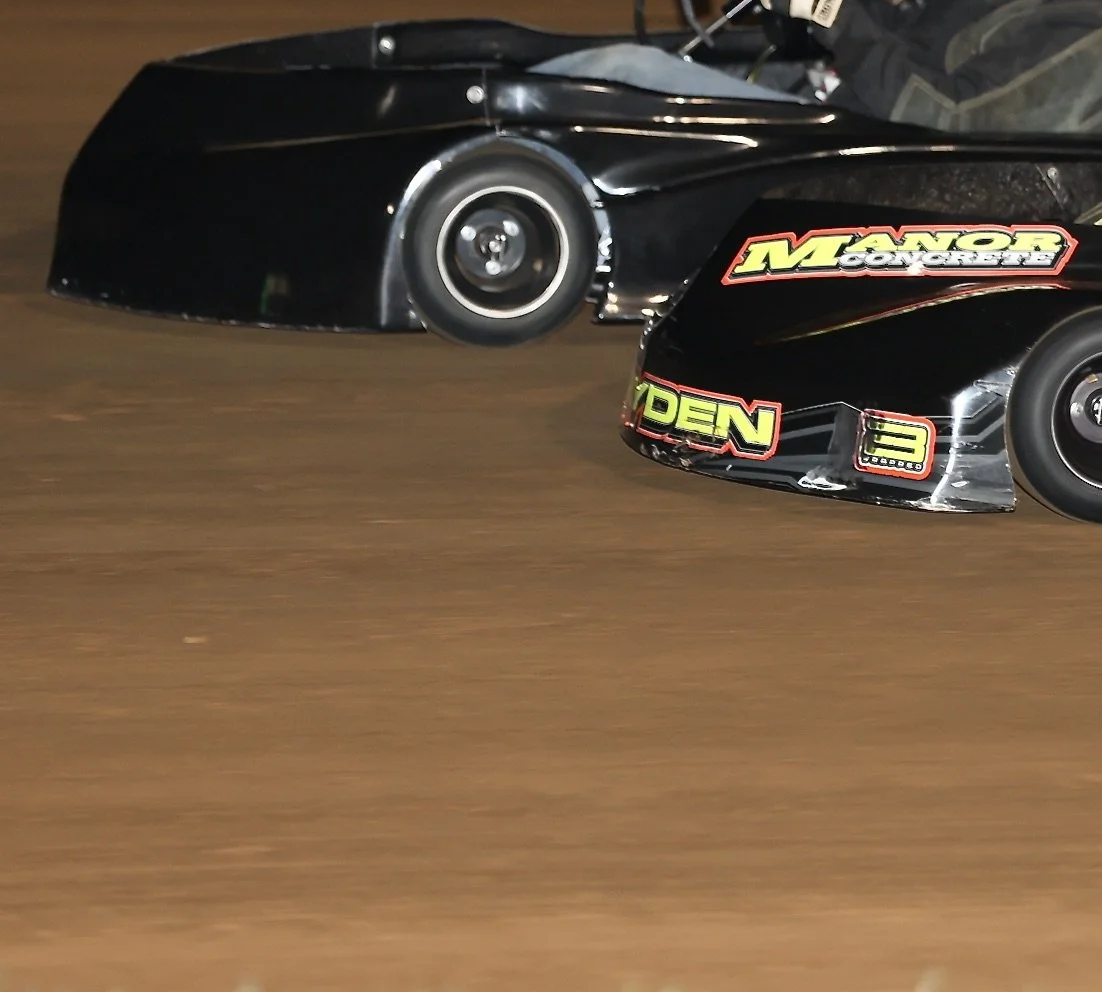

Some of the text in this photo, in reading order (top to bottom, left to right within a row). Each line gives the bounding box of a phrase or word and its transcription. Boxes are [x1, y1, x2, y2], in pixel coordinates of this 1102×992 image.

[733, 230, 1063, 274] MANOR
[838, 250, 1057, 268] CONCRETE
[863, 416, 928, 464] 3
